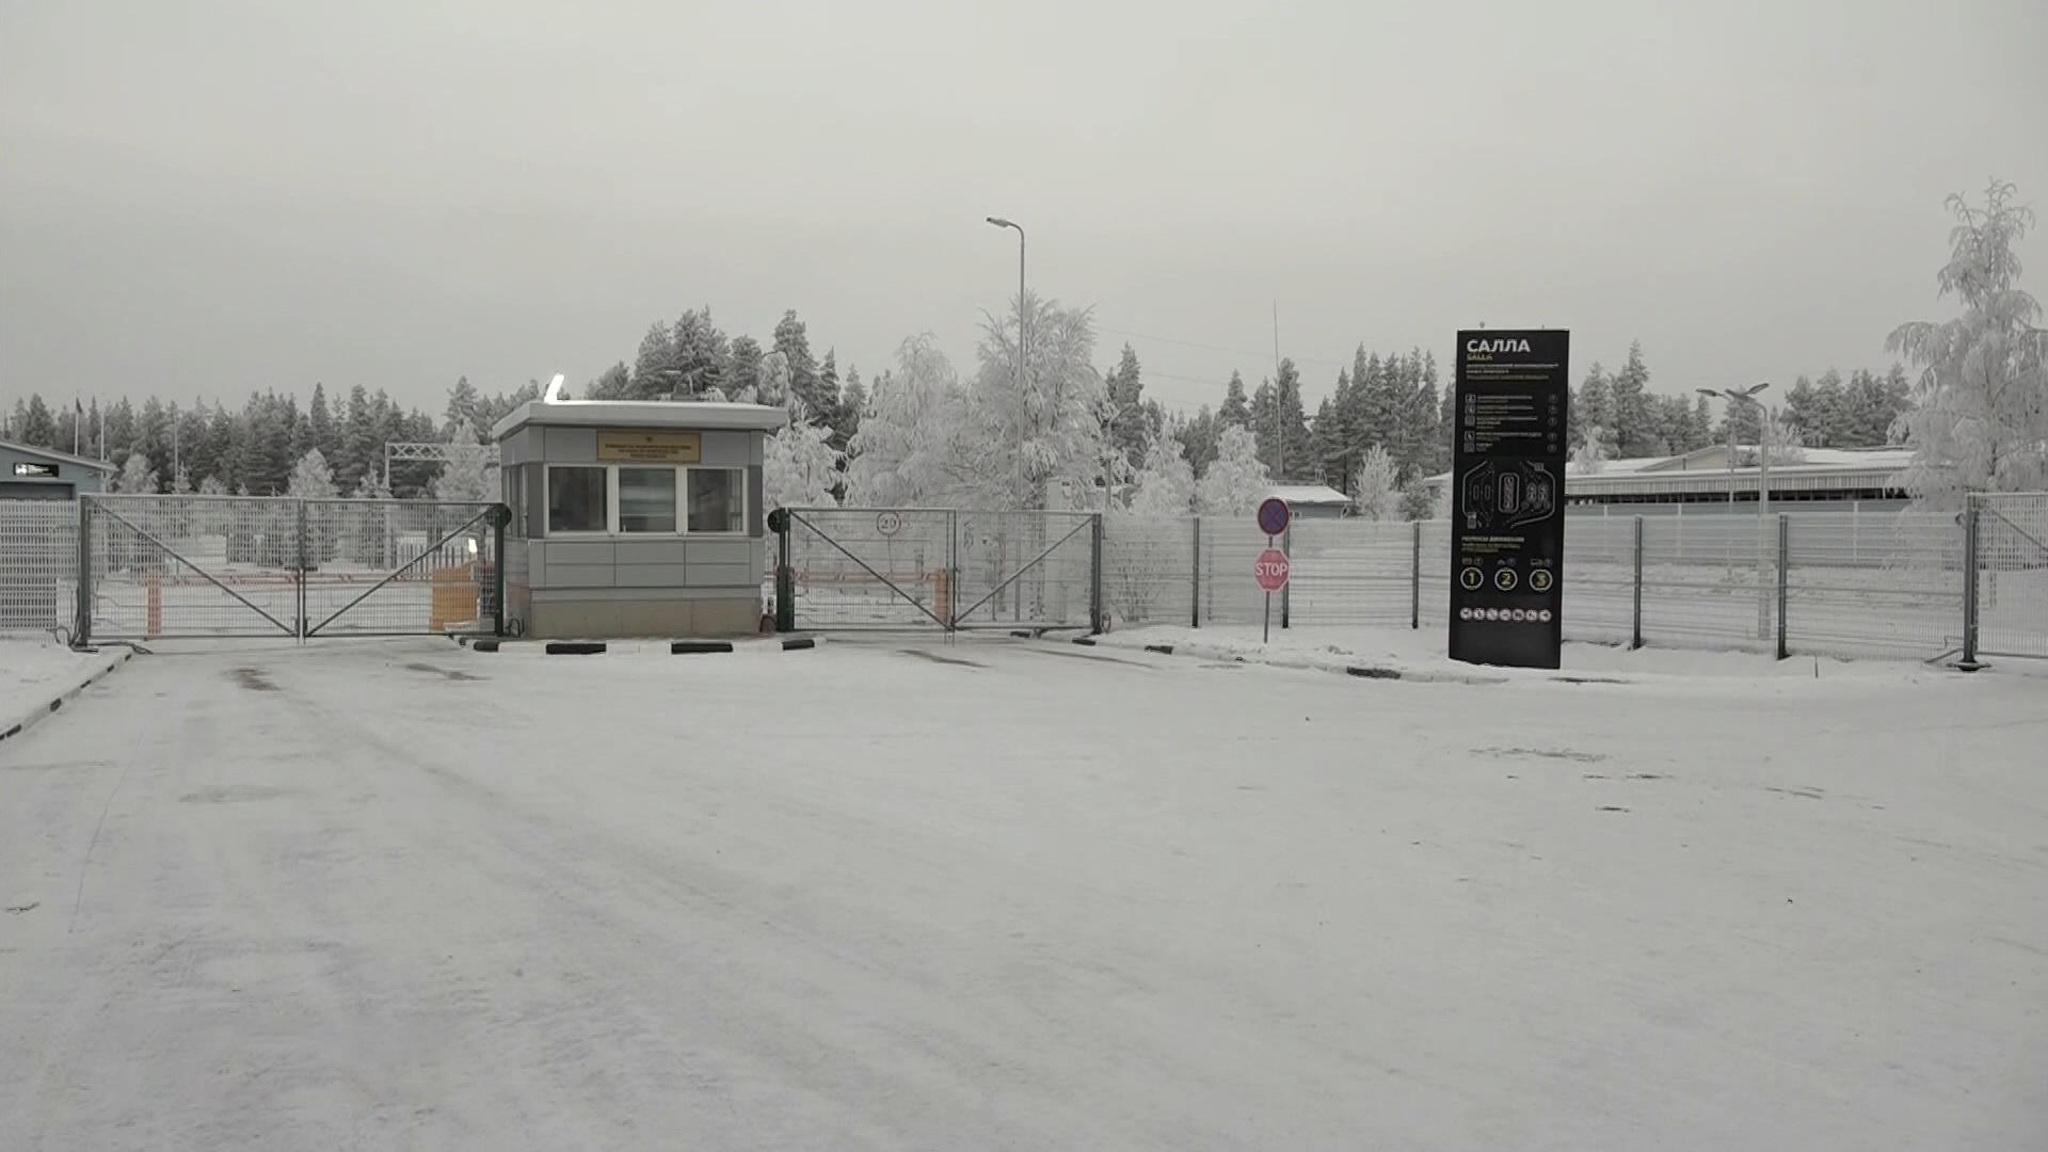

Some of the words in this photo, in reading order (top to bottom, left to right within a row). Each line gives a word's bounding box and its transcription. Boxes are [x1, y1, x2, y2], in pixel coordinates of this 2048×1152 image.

[1467, 339, 1531, 352] САЛЛА
[880, 518, 897, 529] 20
[1256, 562, 1288, 577] STOP
[1468, 573, 1475, 585] 1
[1501, 573, 1511, 585] 2
[1537, 573, 1546, 586] 3
